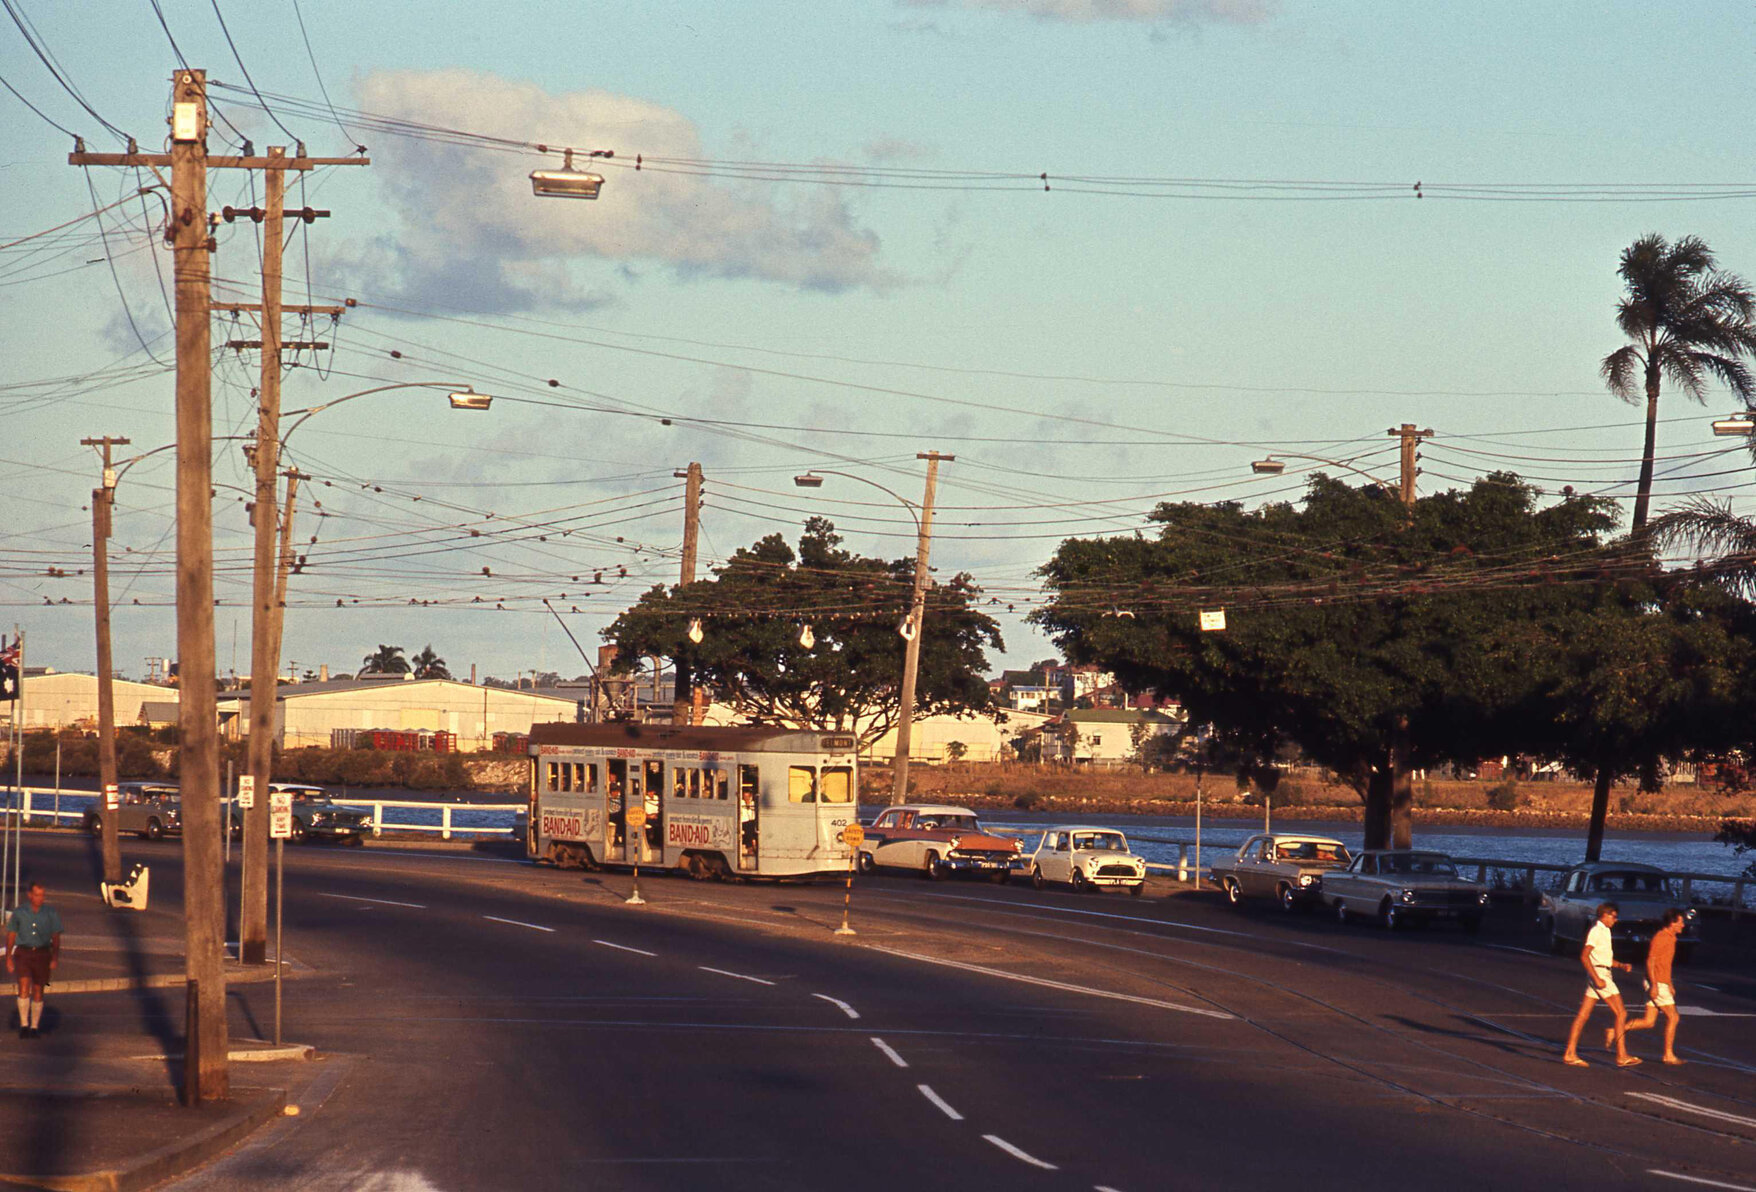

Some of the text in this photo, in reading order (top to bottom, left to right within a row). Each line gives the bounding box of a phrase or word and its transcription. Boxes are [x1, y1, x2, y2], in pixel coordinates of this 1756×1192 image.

[543, 816, 580, 836] BAND-AID
[831, 819, 847, 827] 402
[669, 823, 709, 844] BAND-AID
